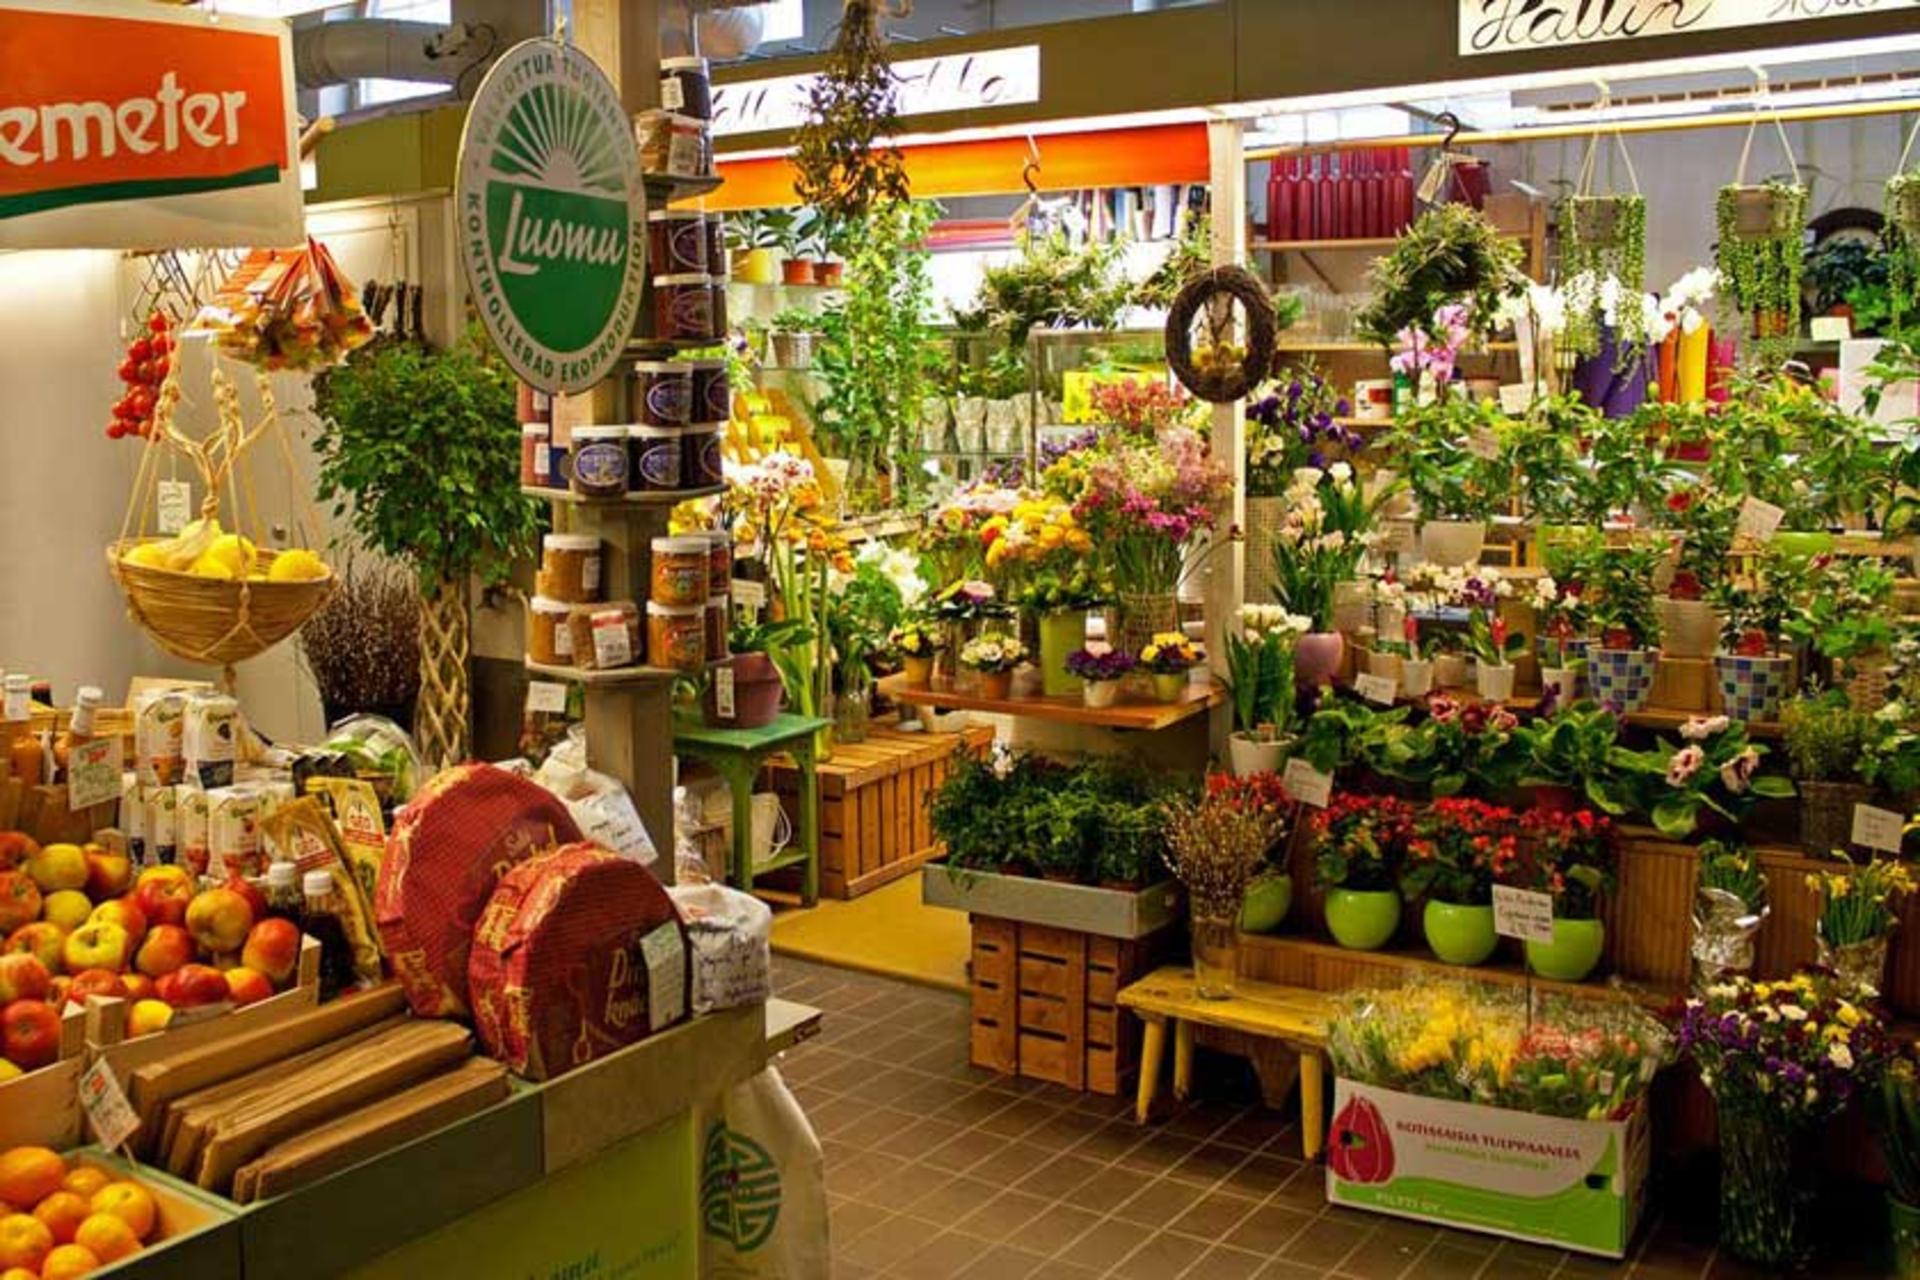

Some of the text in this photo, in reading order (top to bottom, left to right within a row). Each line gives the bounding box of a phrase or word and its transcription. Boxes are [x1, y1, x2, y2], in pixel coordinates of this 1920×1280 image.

[0, 70, 247, 166] emeter
[498, 190, 626, 276] Luomu
[466, 192, 643, 383] KONTROLLERAD EKOPRODUKTION
